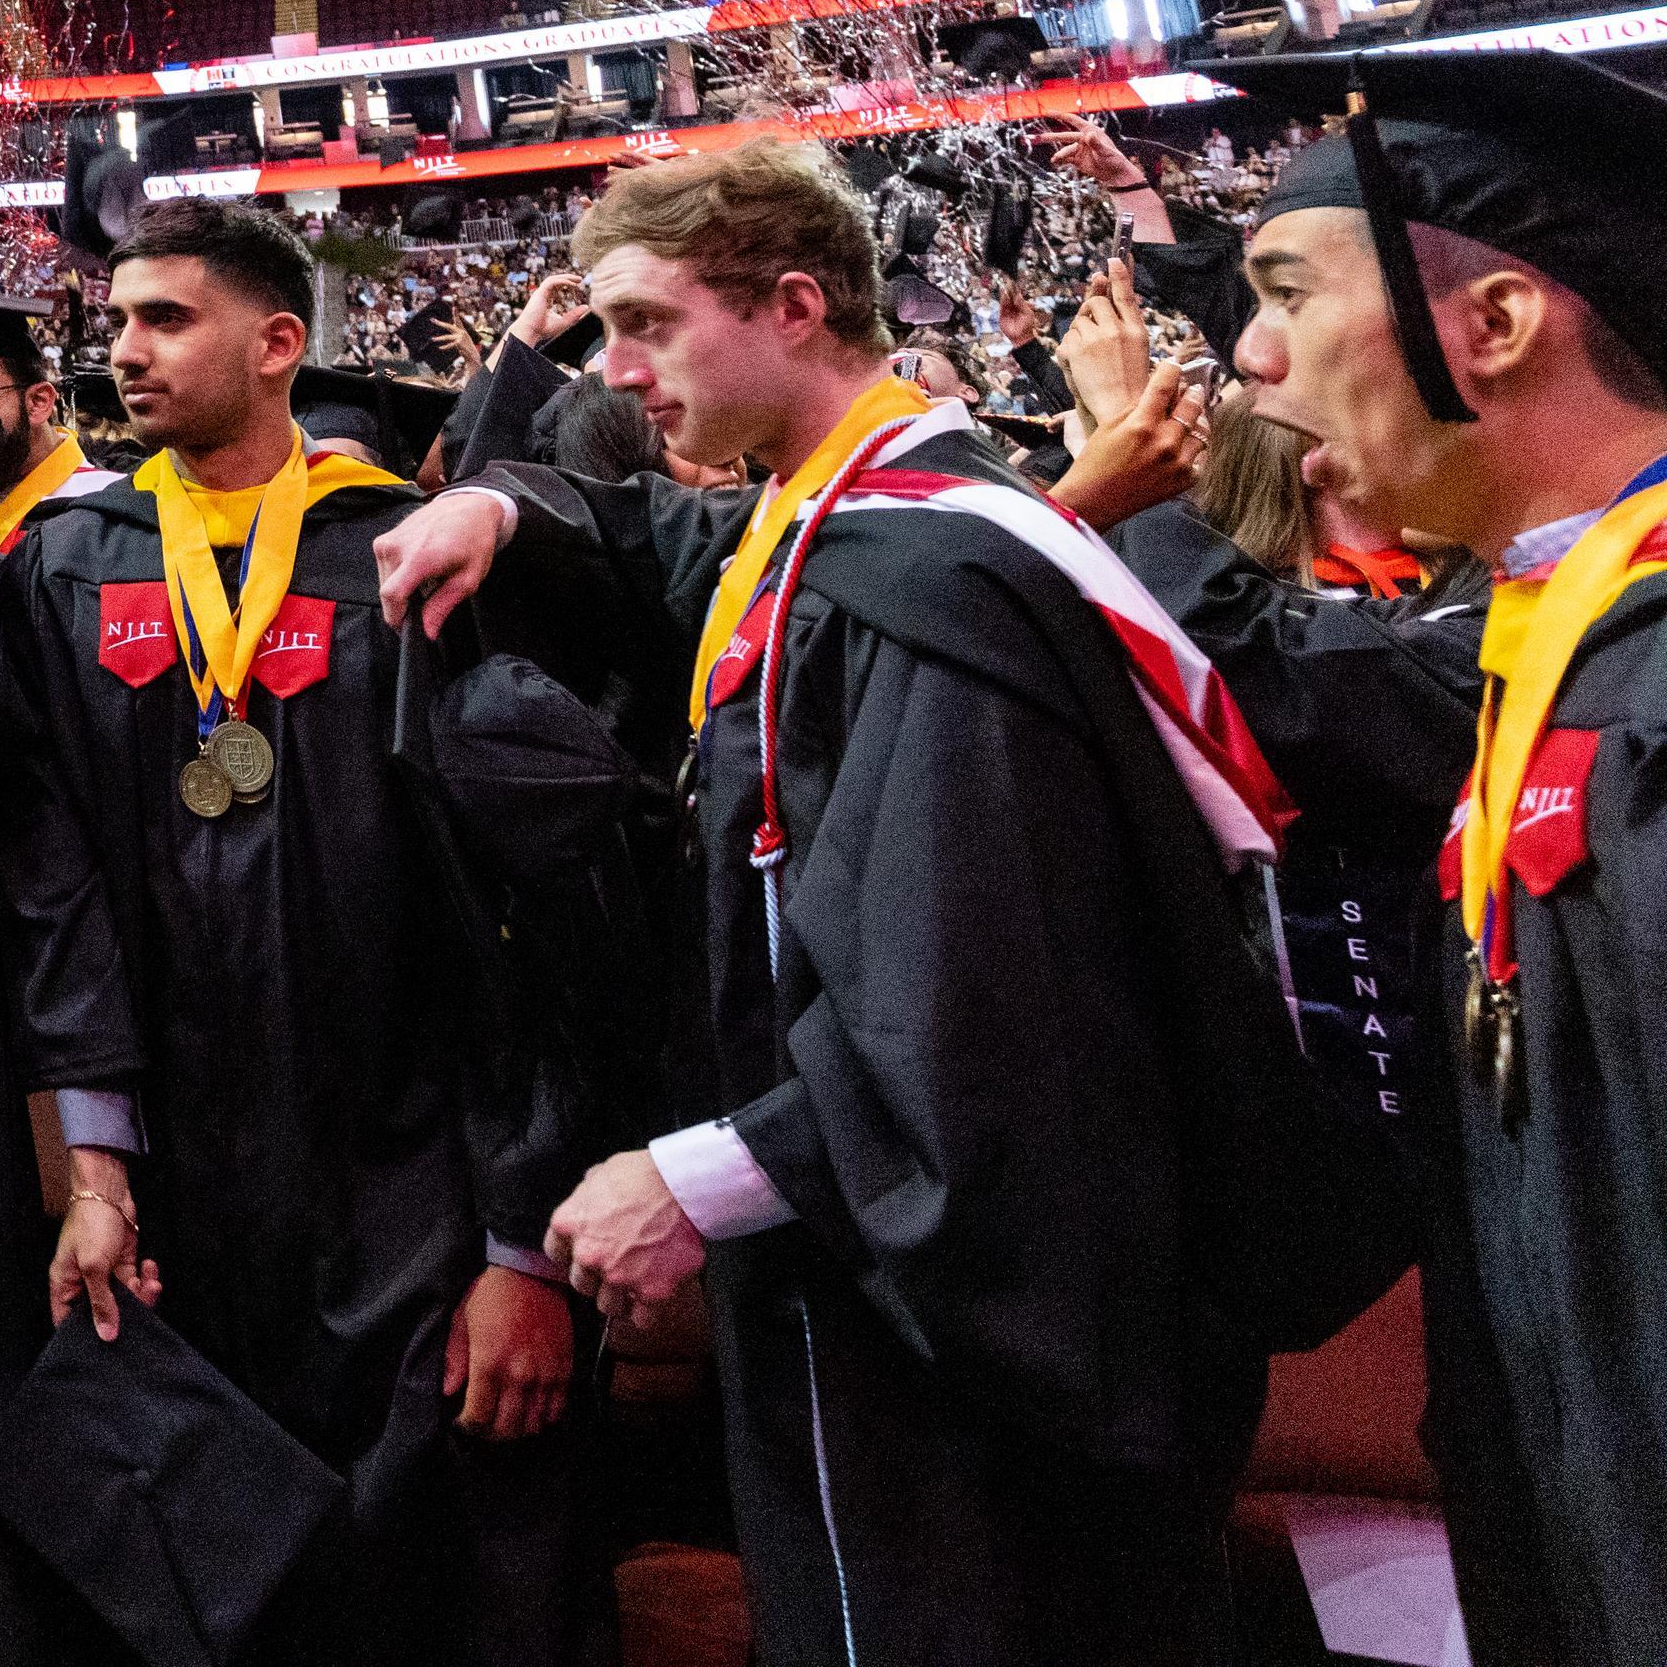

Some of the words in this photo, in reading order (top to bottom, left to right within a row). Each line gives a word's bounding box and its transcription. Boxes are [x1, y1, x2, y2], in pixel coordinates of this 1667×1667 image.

[266, 36, 514, 80] CONGRATULATIONS
[523, 16, 683, 50] GRADUATES
[624, 131, 672, 151] NJIT
[413, 154, 457, 172] NJIT
[146, 177, 235, 197] DUATES
[107, 620, 164, 640] NJIT
[260, 629, 318, 649] NJIT
[1519, 786, 1575, 814] NJIT
[1340, 900, 1401, 1114] SENATE
